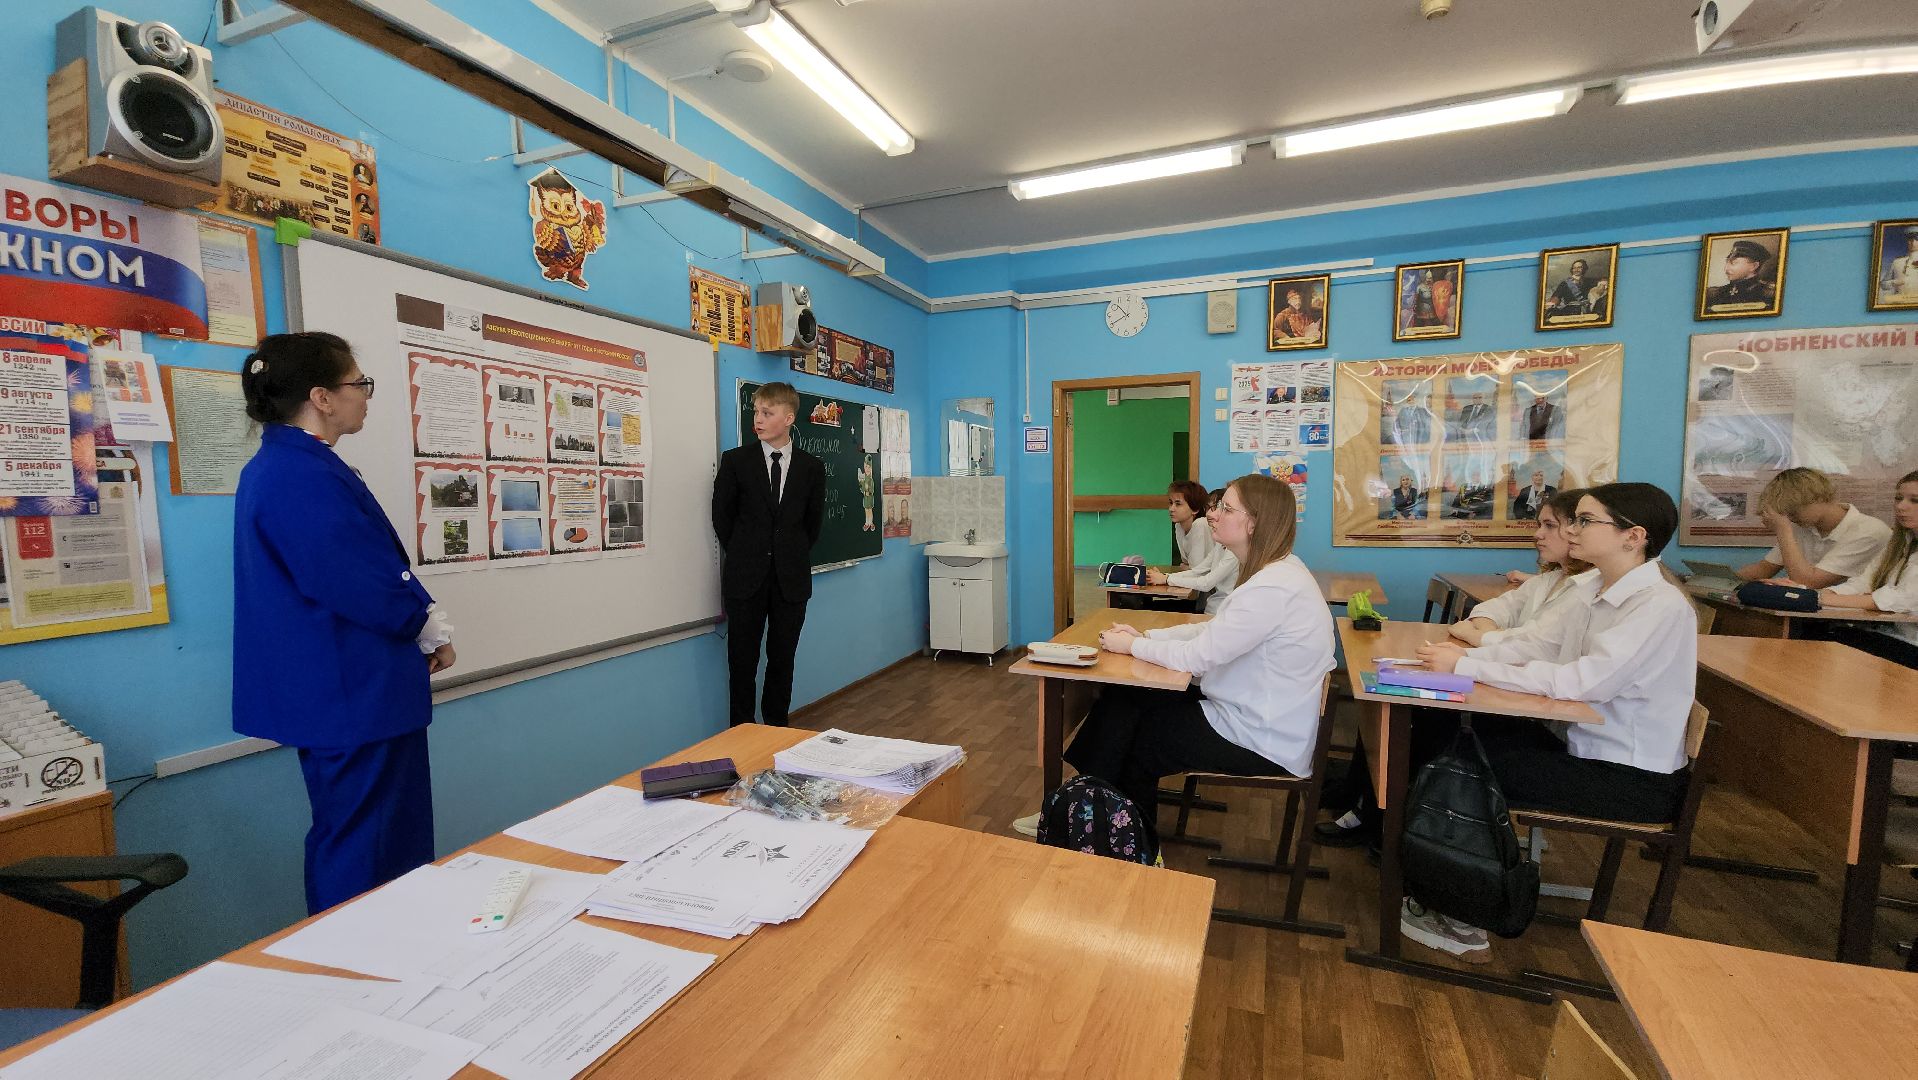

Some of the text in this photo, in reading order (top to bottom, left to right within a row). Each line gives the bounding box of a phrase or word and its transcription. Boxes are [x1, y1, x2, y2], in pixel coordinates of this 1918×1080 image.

[283, 118, 341, 145] РОМАНОВЫХ
[5, 188, 139, 244] ВОРЫ
[13, 355, 52, 364] апреля
[12, 389, 53, 400] августа
[15, 425, 65, 434] сентября
[1309, 431, 1320, 441] 80
[5, 461, 62, 471] 5 декабря
[24, 527, 46, 535] 112
